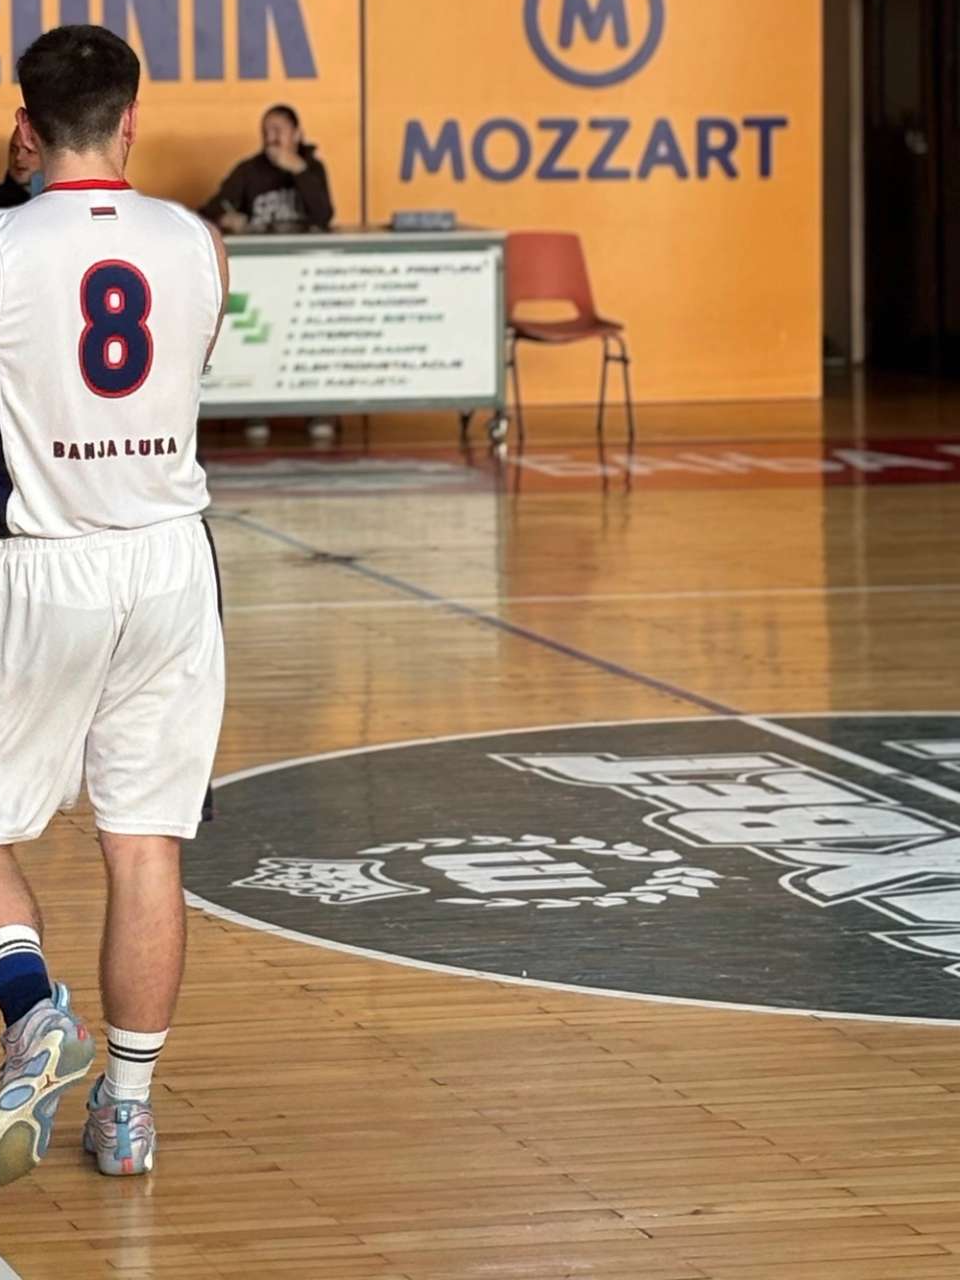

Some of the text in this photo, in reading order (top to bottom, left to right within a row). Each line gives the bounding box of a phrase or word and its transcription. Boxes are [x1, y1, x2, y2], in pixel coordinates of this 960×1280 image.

[400, 118, 790, 184] MOZZART
[78, 259, 154, 399] 8
[52, 437, 178, 460] BANJA LUKA
